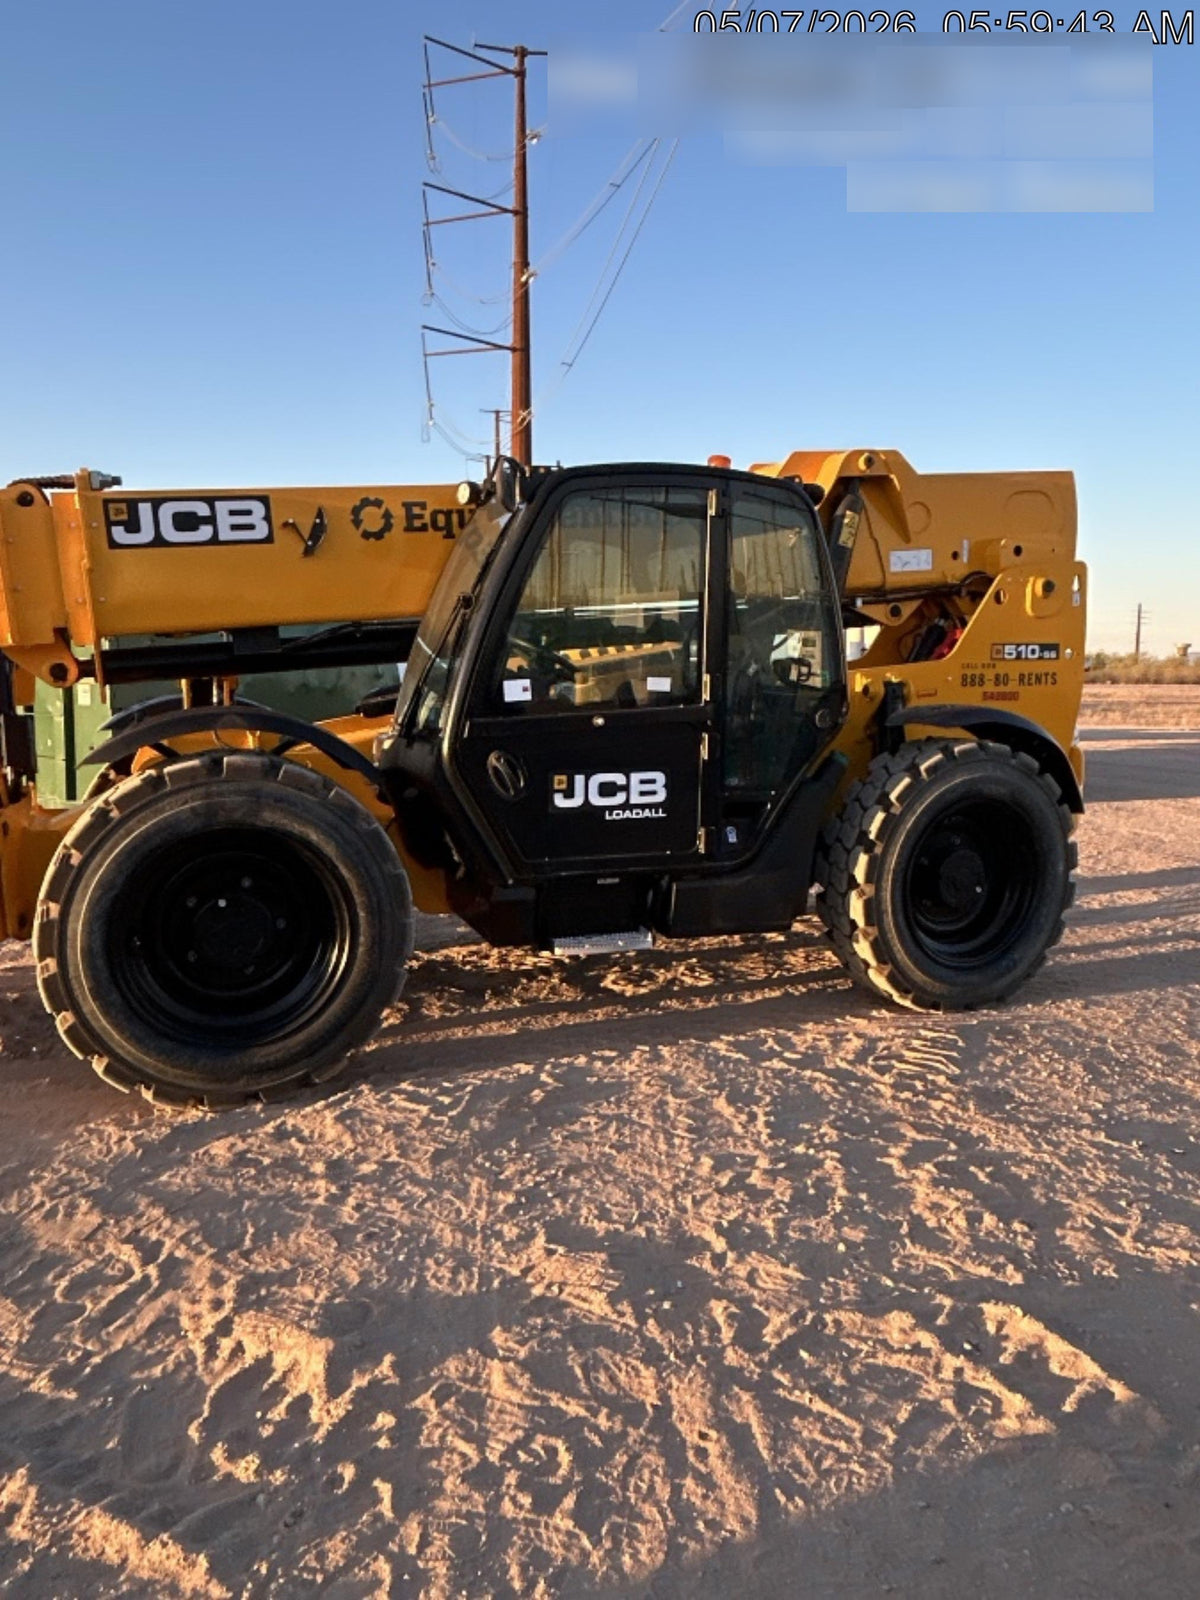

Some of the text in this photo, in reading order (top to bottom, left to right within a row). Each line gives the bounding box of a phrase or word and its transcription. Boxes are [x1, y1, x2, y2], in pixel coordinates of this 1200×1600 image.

[111, 499, 271, 545] JCB
[553, 770, 668, 808] JCB
[605, 808, 668, 821] LOADALL
